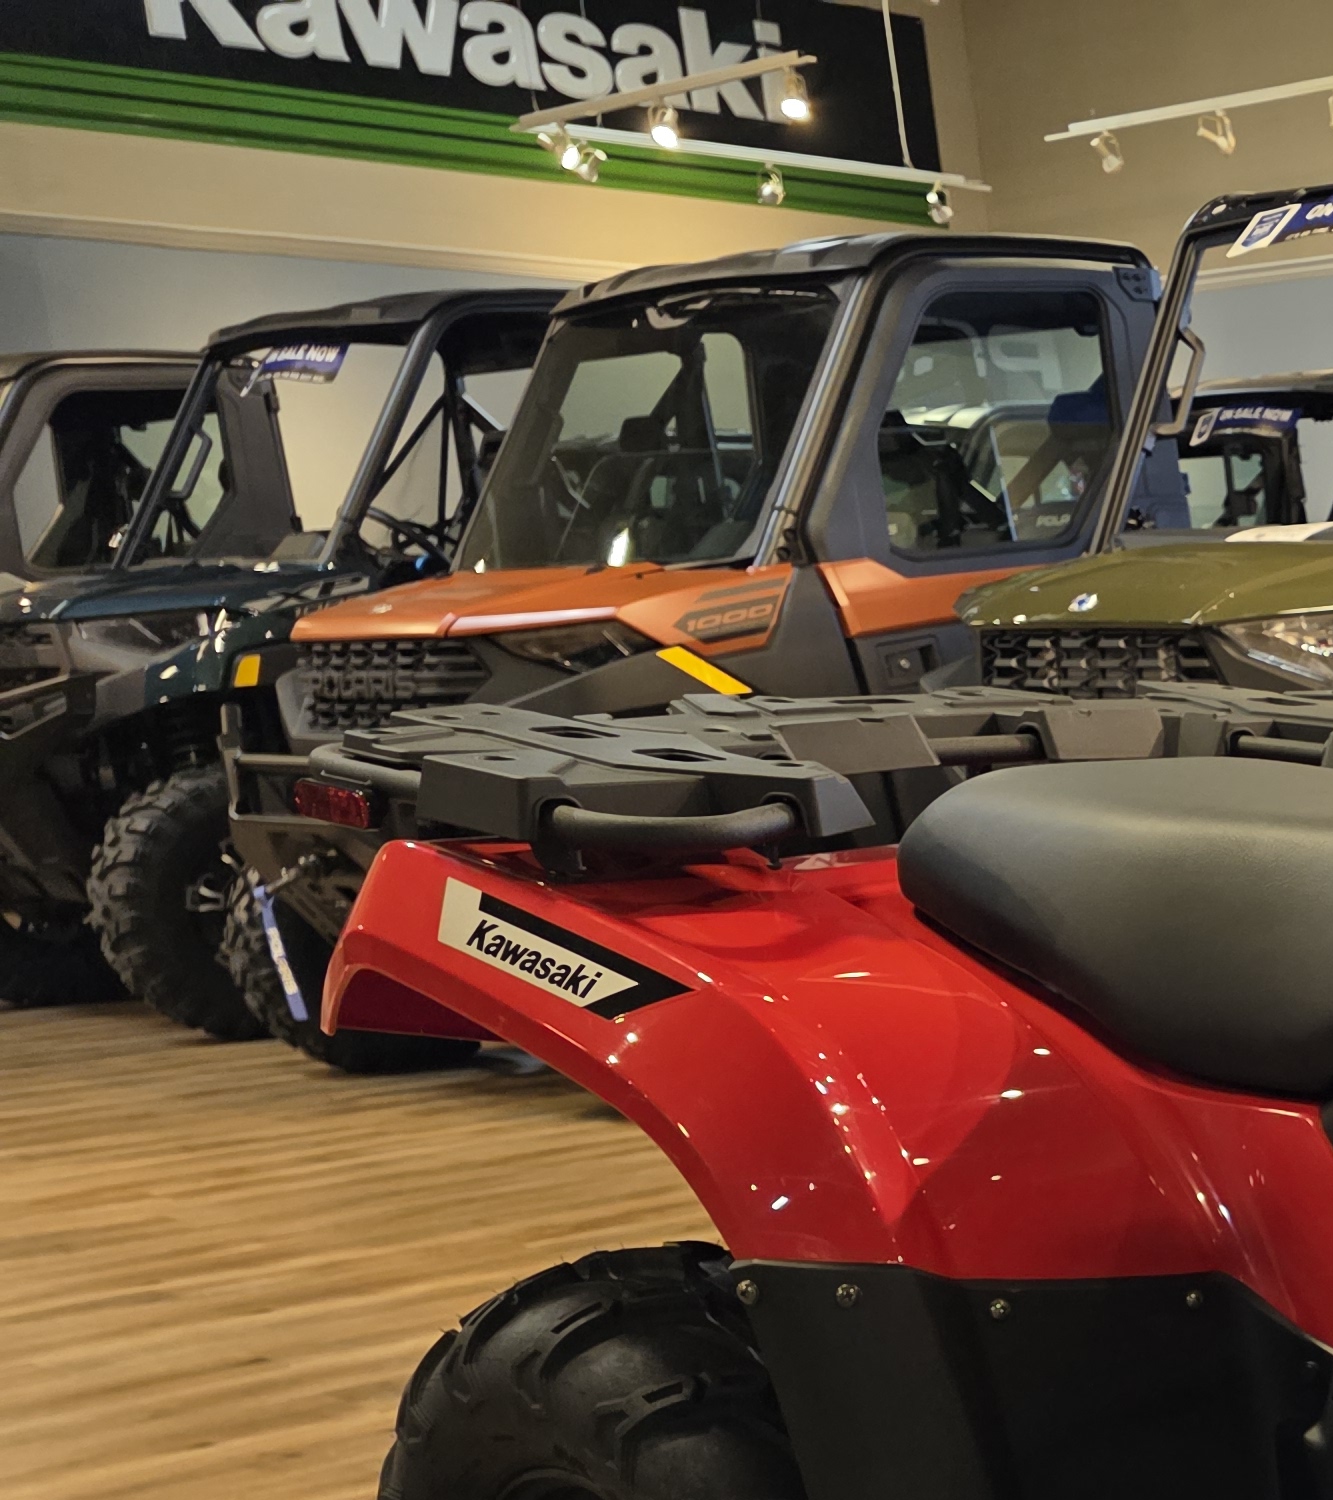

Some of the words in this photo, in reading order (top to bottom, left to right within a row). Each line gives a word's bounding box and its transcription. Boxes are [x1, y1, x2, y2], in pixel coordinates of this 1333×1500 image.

[686, 603, 773, 633] 1000
[303, 669, 416, 699] POLARIS
[466, 919, 603, 999] Kawasaki
